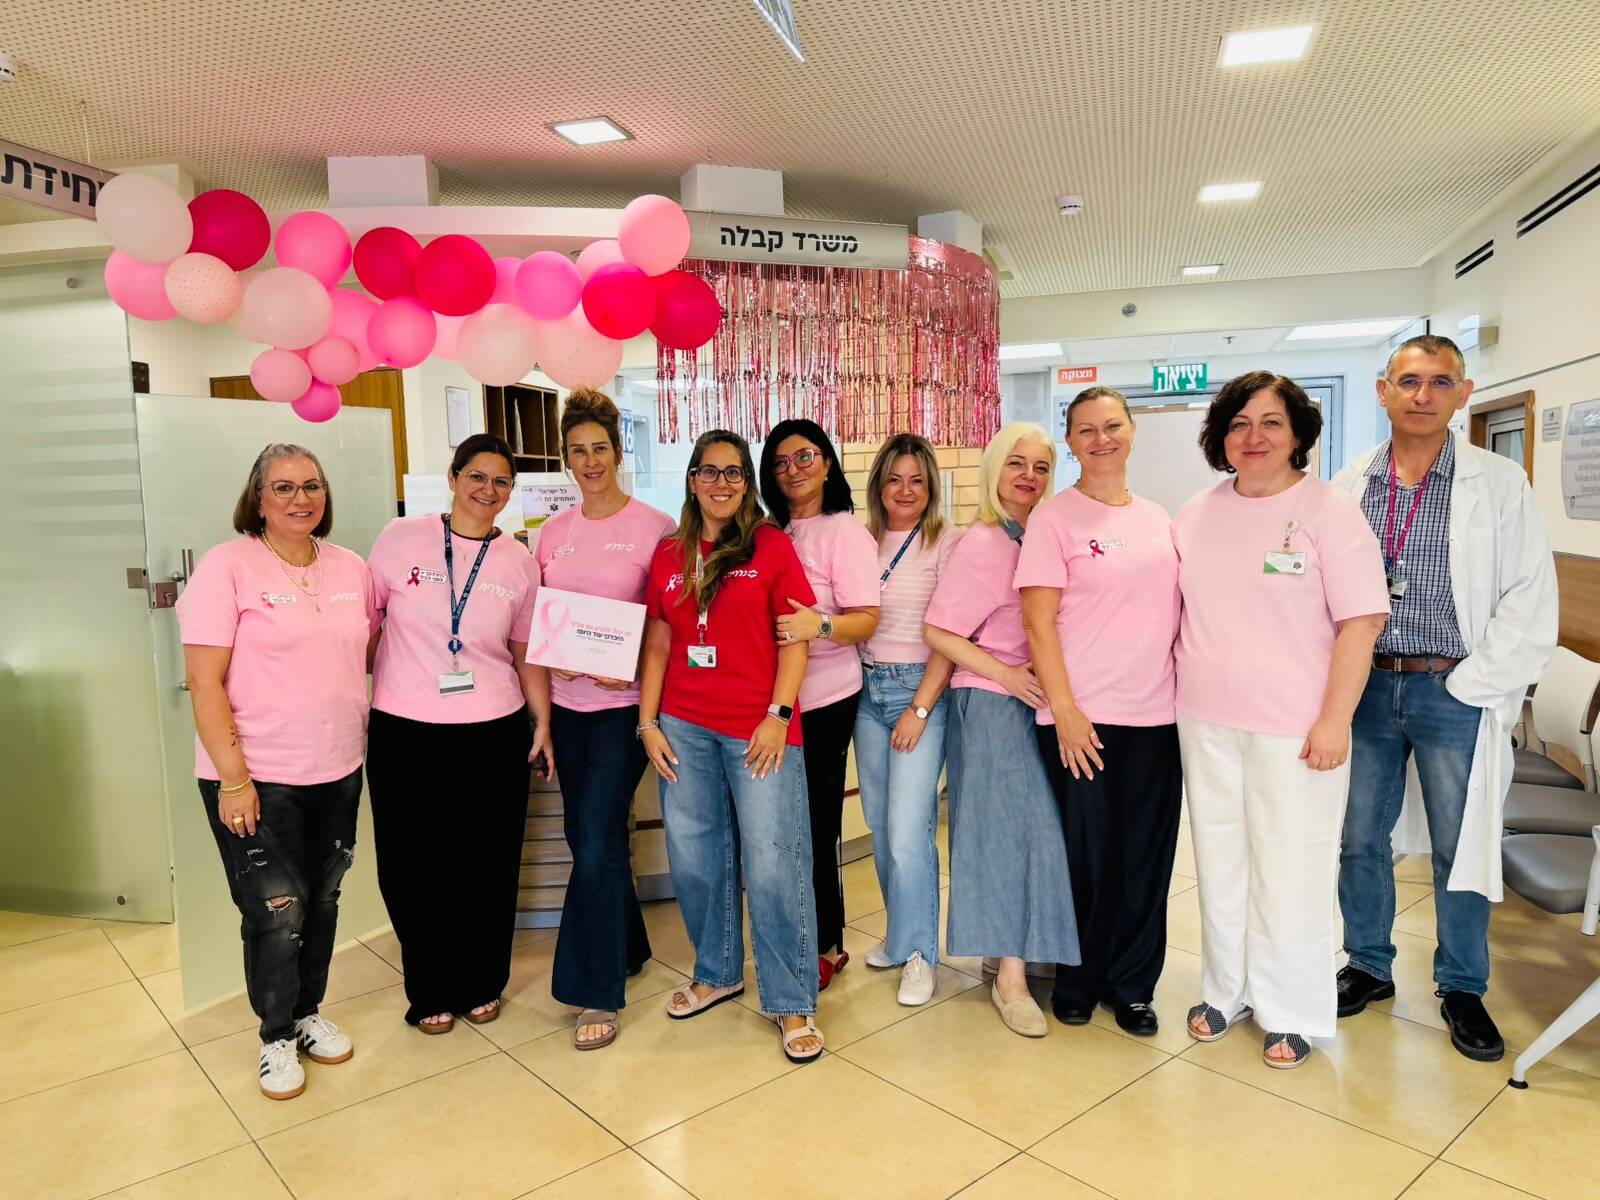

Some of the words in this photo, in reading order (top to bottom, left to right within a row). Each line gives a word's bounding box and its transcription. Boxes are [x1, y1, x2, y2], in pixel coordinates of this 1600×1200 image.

[1, 153, 105, 208] חידת
[720, 225, 783, 252] קבלה
[792, 231, 859, 253] משרד
[1061, 368, 1093, 381] מצוקה
[1157, 364, 1203, 391] יציאה
